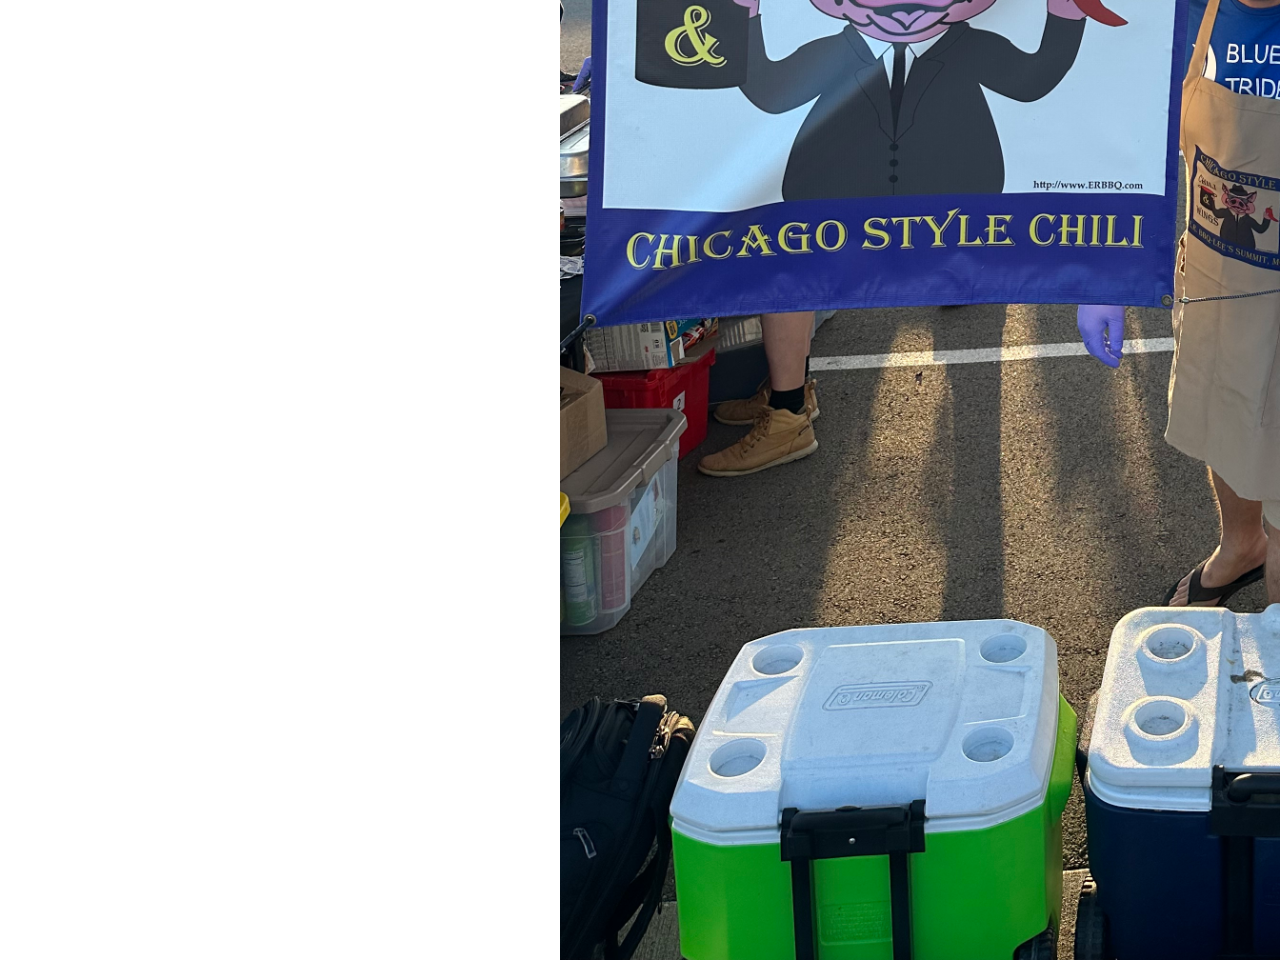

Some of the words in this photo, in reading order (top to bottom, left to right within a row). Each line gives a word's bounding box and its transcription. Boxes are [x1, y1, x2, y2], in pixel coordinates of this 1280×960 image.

[664, 5, 728, 68] &
[1200, 154, 1236, 180] CHICAGO
[1239, 174, 1276, 190] STYLE
[1033, 180, 1143, 191] http://www.ERBBQ.com
[1202, 194, 1210, 204] &
[626, 219, 849, 270] CHICAGO
[862, 207, 1016, 250] STYLE
[1029, 213, 1145, 248] CHILI
[854, 689, 916, 703] Coleman
